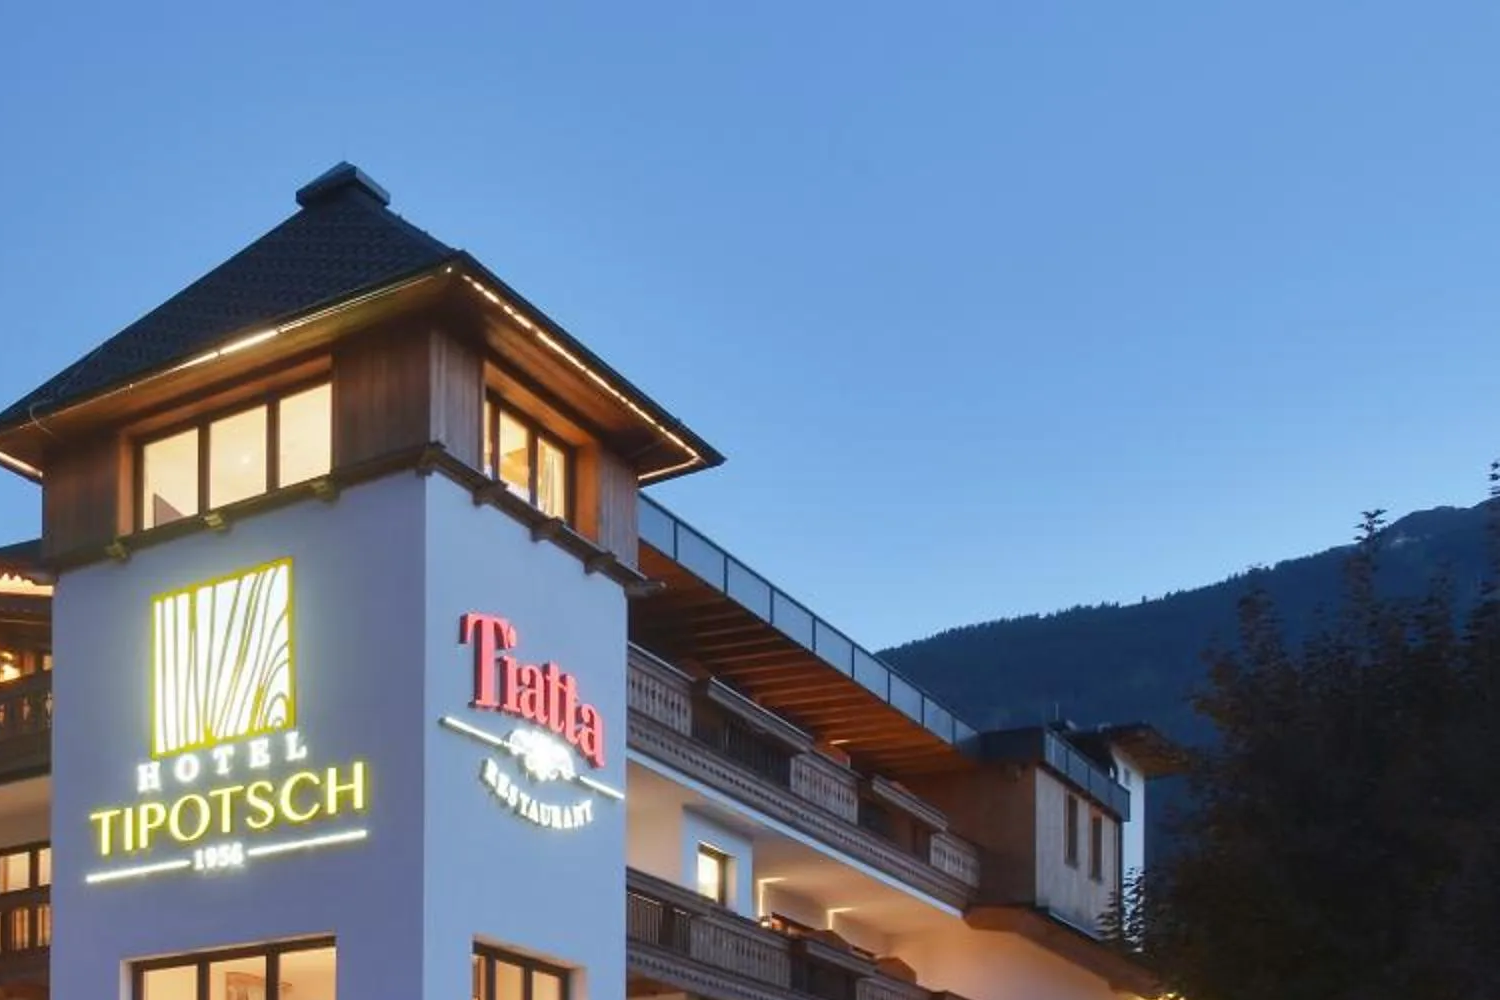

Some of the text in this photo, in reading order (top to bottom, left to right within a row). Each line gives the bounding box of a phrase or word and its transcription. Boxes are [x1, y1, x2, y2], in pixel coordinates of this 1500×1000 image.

[459, 612, 606, 769] Tiatta
[137, 731, 308, 794] HOTEL
[481, 756, 594, 830] RESTAURANT
[90, 761, 366, 855] TIPOTSCH
